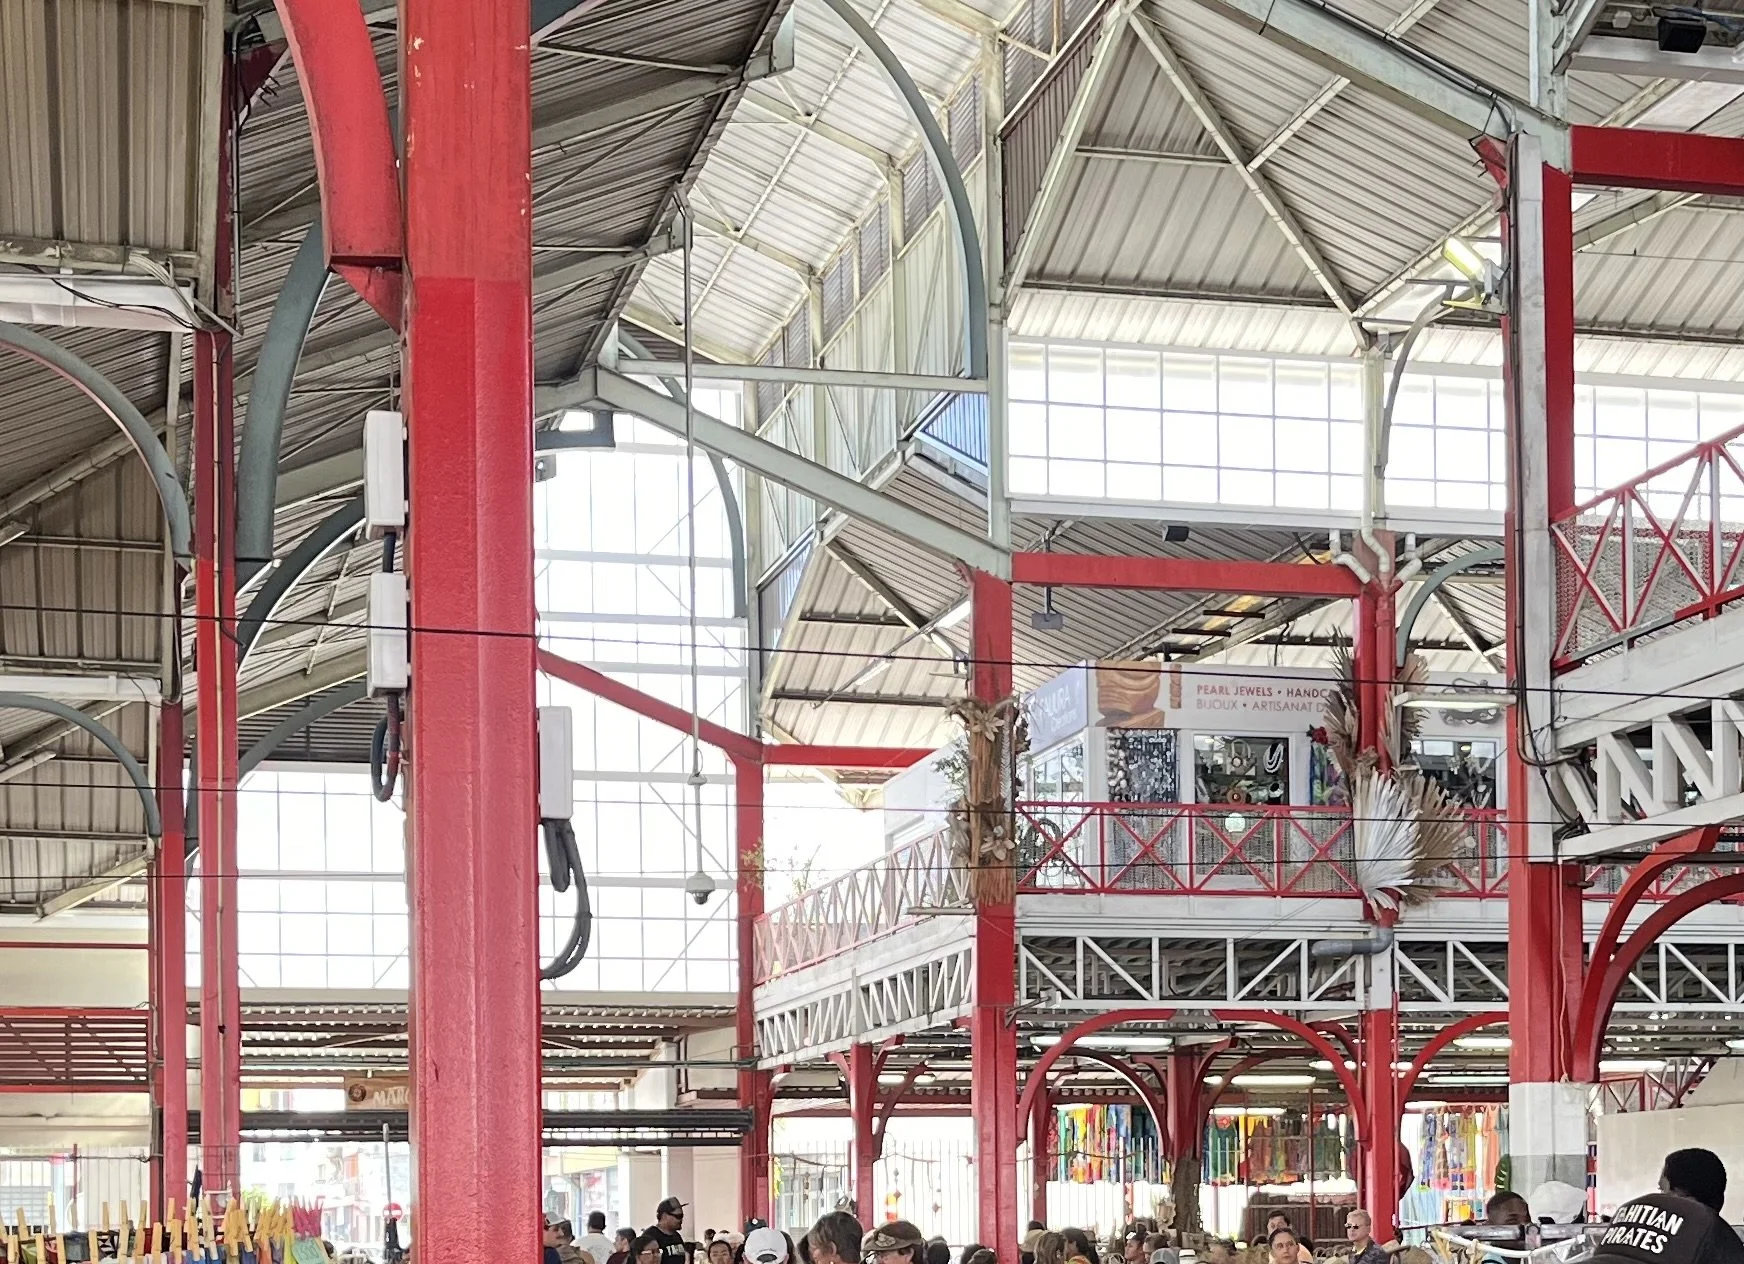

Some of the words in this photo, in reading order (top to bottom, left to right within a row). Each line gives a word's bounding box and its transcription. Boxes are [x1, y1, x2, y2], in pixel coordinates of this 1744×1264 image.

[1196, 684, 1230, 696] PEARL
[1233, 686, 1273, 697] JEWELS
[1286, 688, 1329, 699] HANDC
[1252, 701, 1312, 712] ARTISANAT
[1612, 1204, 1684, 1236] TAHITIAN
[1600, 1226, 1668, 1254] PIRATES
